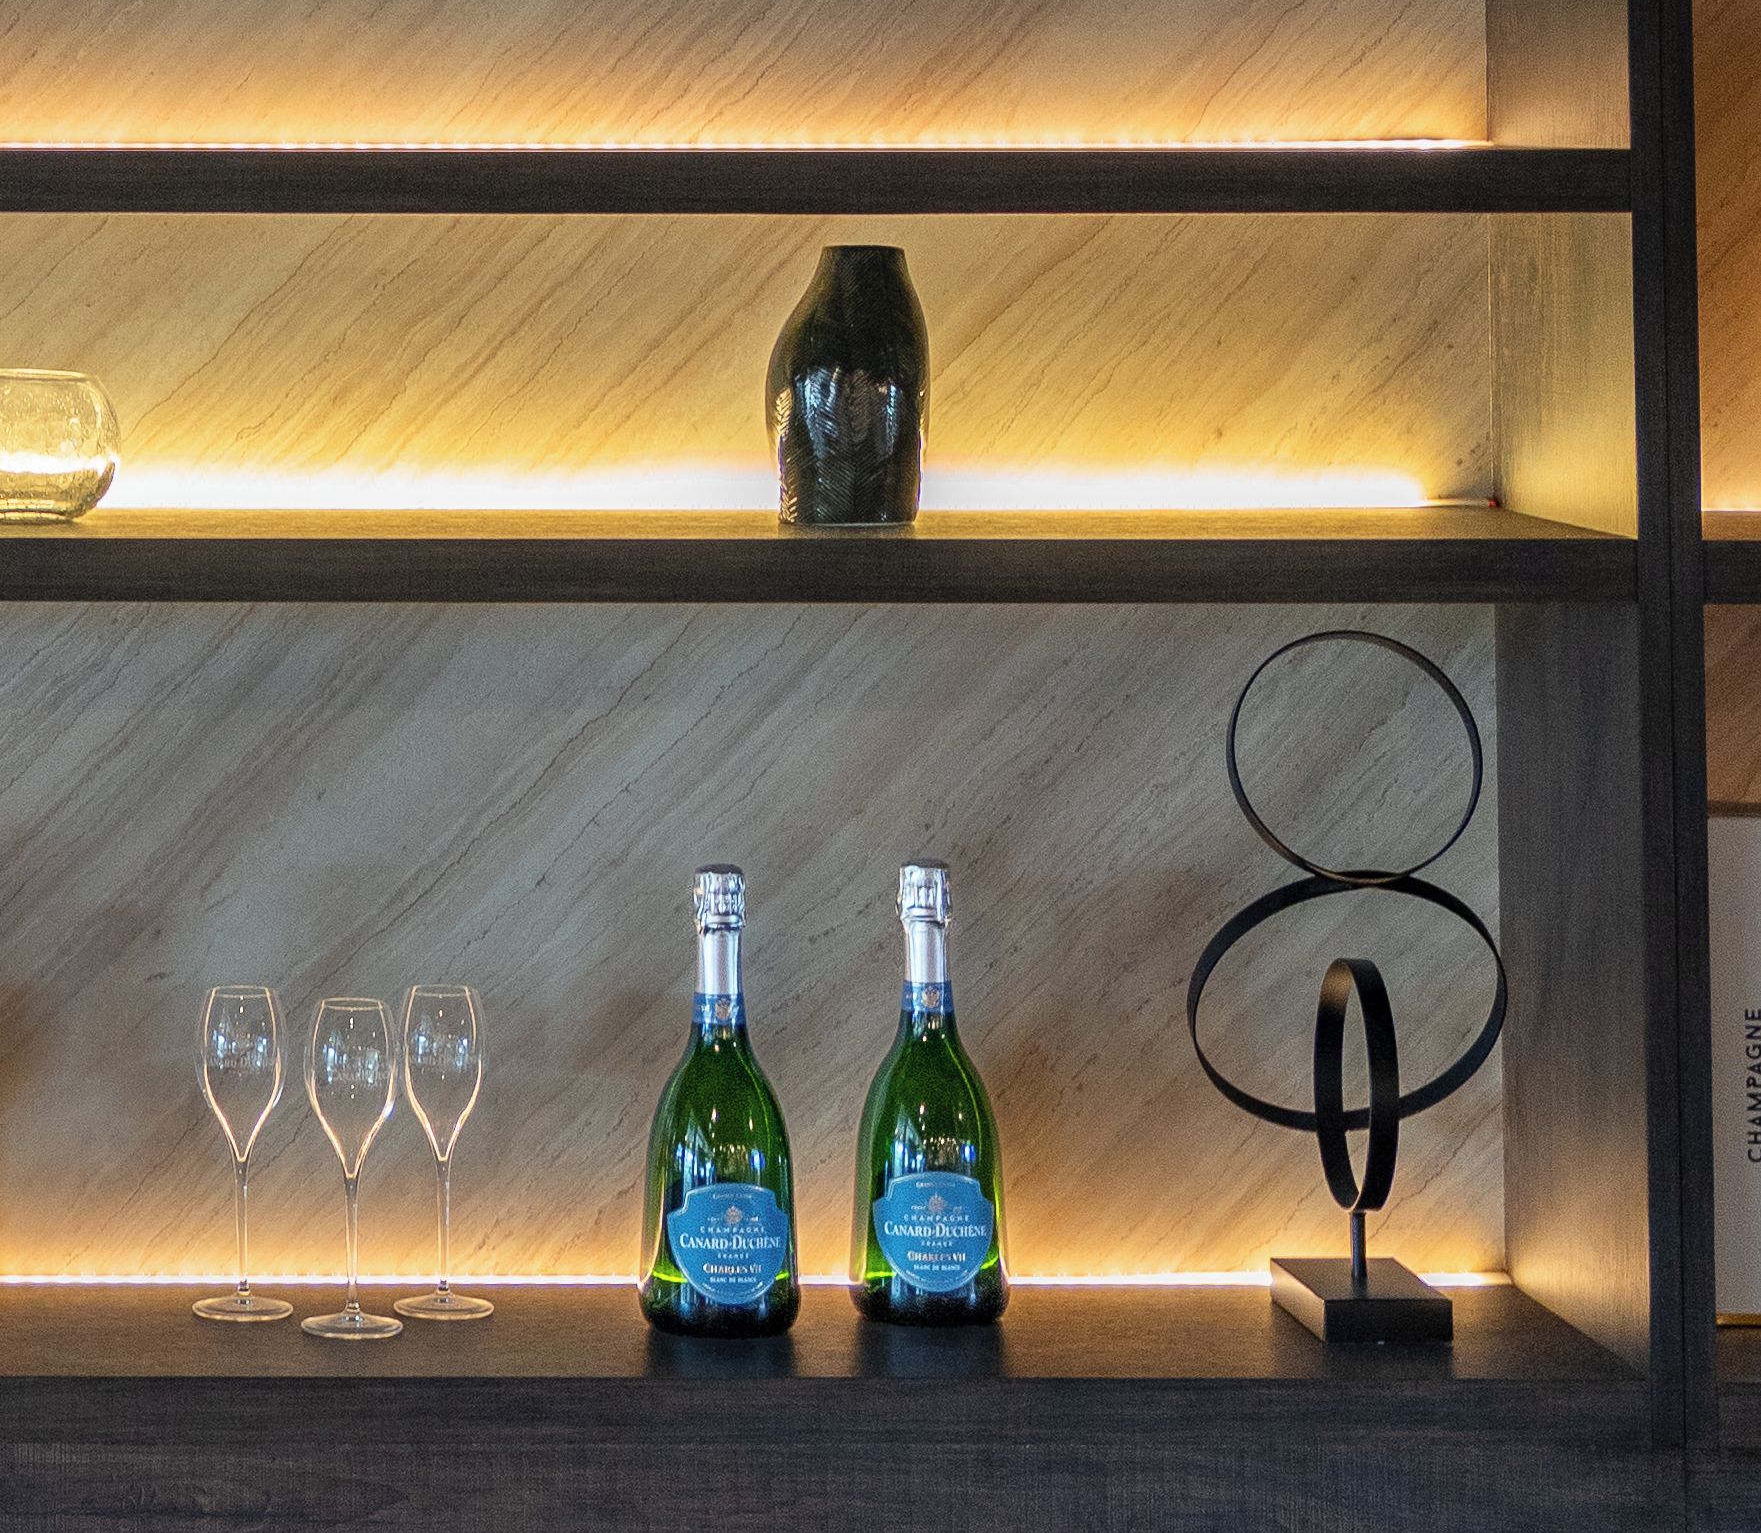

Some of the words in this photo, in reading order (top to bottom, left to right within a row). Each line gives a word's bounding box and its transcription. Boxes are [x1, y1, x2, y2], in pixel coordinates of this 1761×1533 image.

[1745, 1008, 1761, 1163] CHAMPAGNE
[903, 1213, 970, 1222] CHAMPAGNE
[700, 1226, 765, 1234] CHAMPAGNE
[884, 1219, 987, 1238] CANARD-DUCHÊNE
